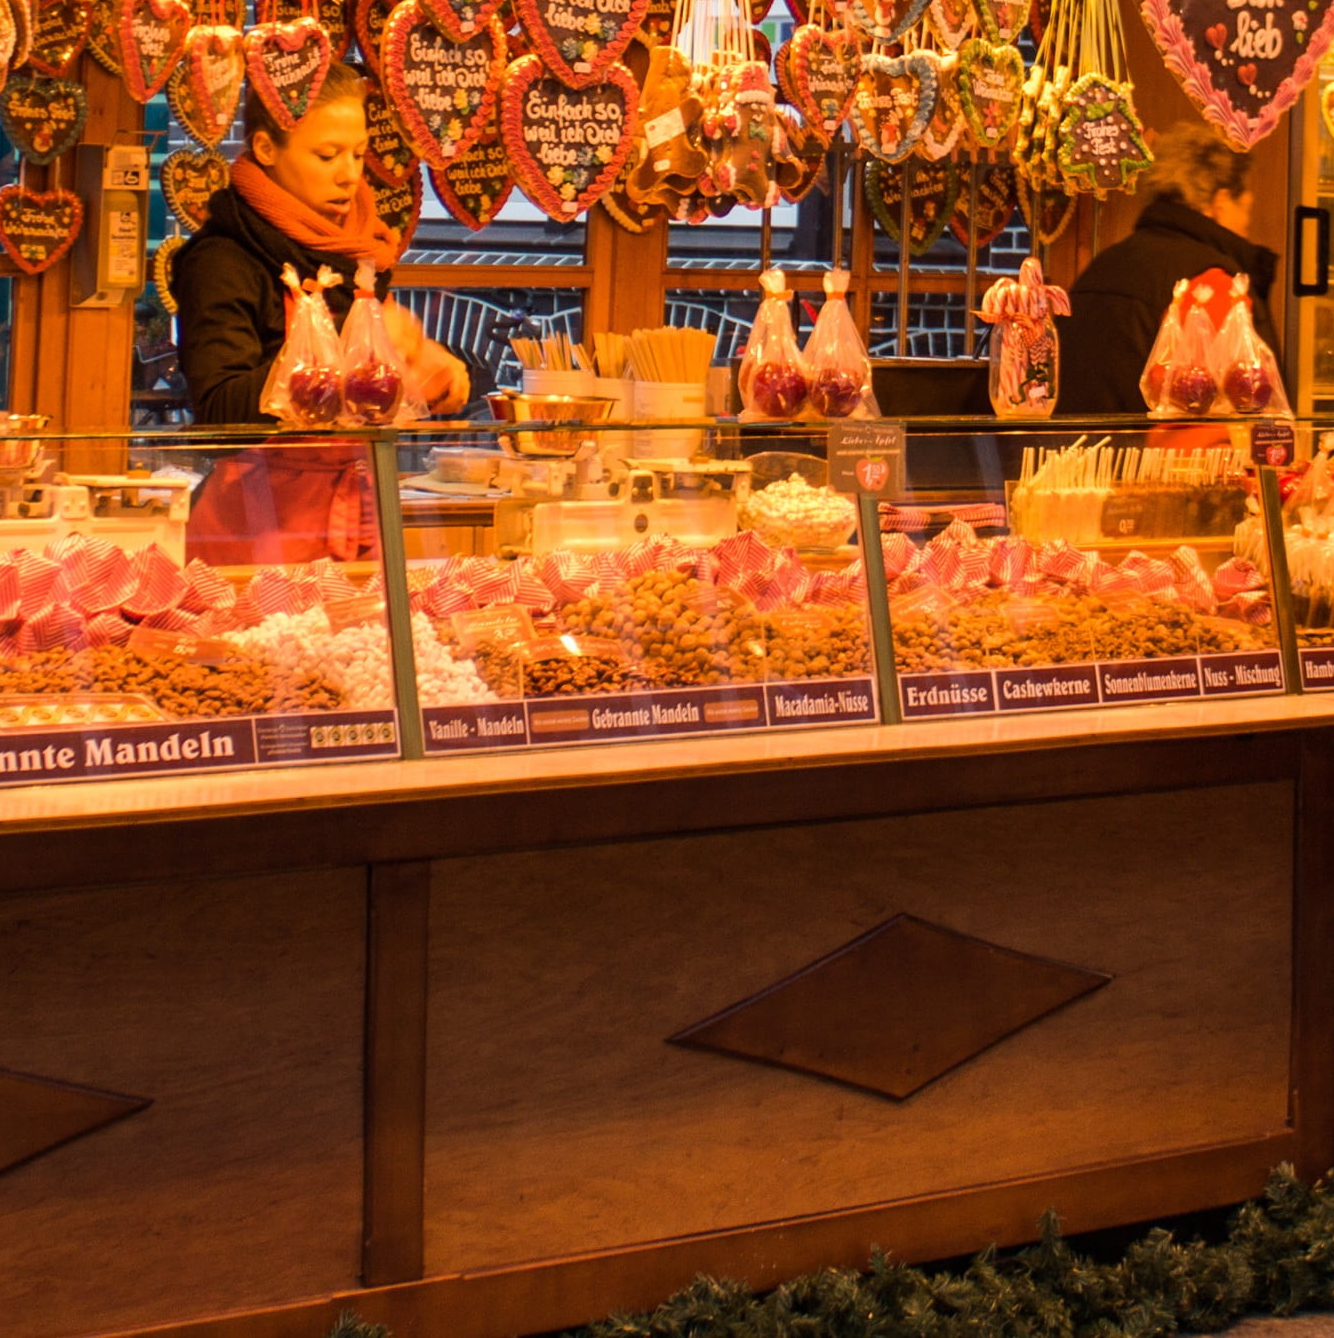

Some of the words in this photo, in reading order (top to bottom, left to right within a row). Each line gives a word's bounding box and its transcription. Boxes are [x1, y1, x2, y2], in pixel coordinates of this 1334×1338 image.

[545, 4, 585, 33] liebe
[1230, 11, 1283, 59] lieb
[409, 32, 462, 70] Einfach
[415, 88, 452, 112] liebe
[526, 90, 593, 127] Einfach
[1082, 119, 1120, 140] Frohes
[537, 144, 577, 167] liebe
[1090, 136, 1117, 156] Fest
[1104, 670, 1197, 695] Sonnenblumenkerne
[1204, 666, 1229, 688] Nuss
[1234, 663, 1281, 688] Mischung
[907, 683, 988, 707] Erdnüsse
[1003, 677, 1091, 700] Cashewkerne
[592, 706, 651, 729] Gebrannte
[651, 702, 700, 724] Mandeln
[775, 691, 869, 718] Macadamia-Nüsse
[429, 714, 469, 740] Vanille
[477, 716, 524, 736] Mandeln
[84, 731, 236, 769] Mandeln
